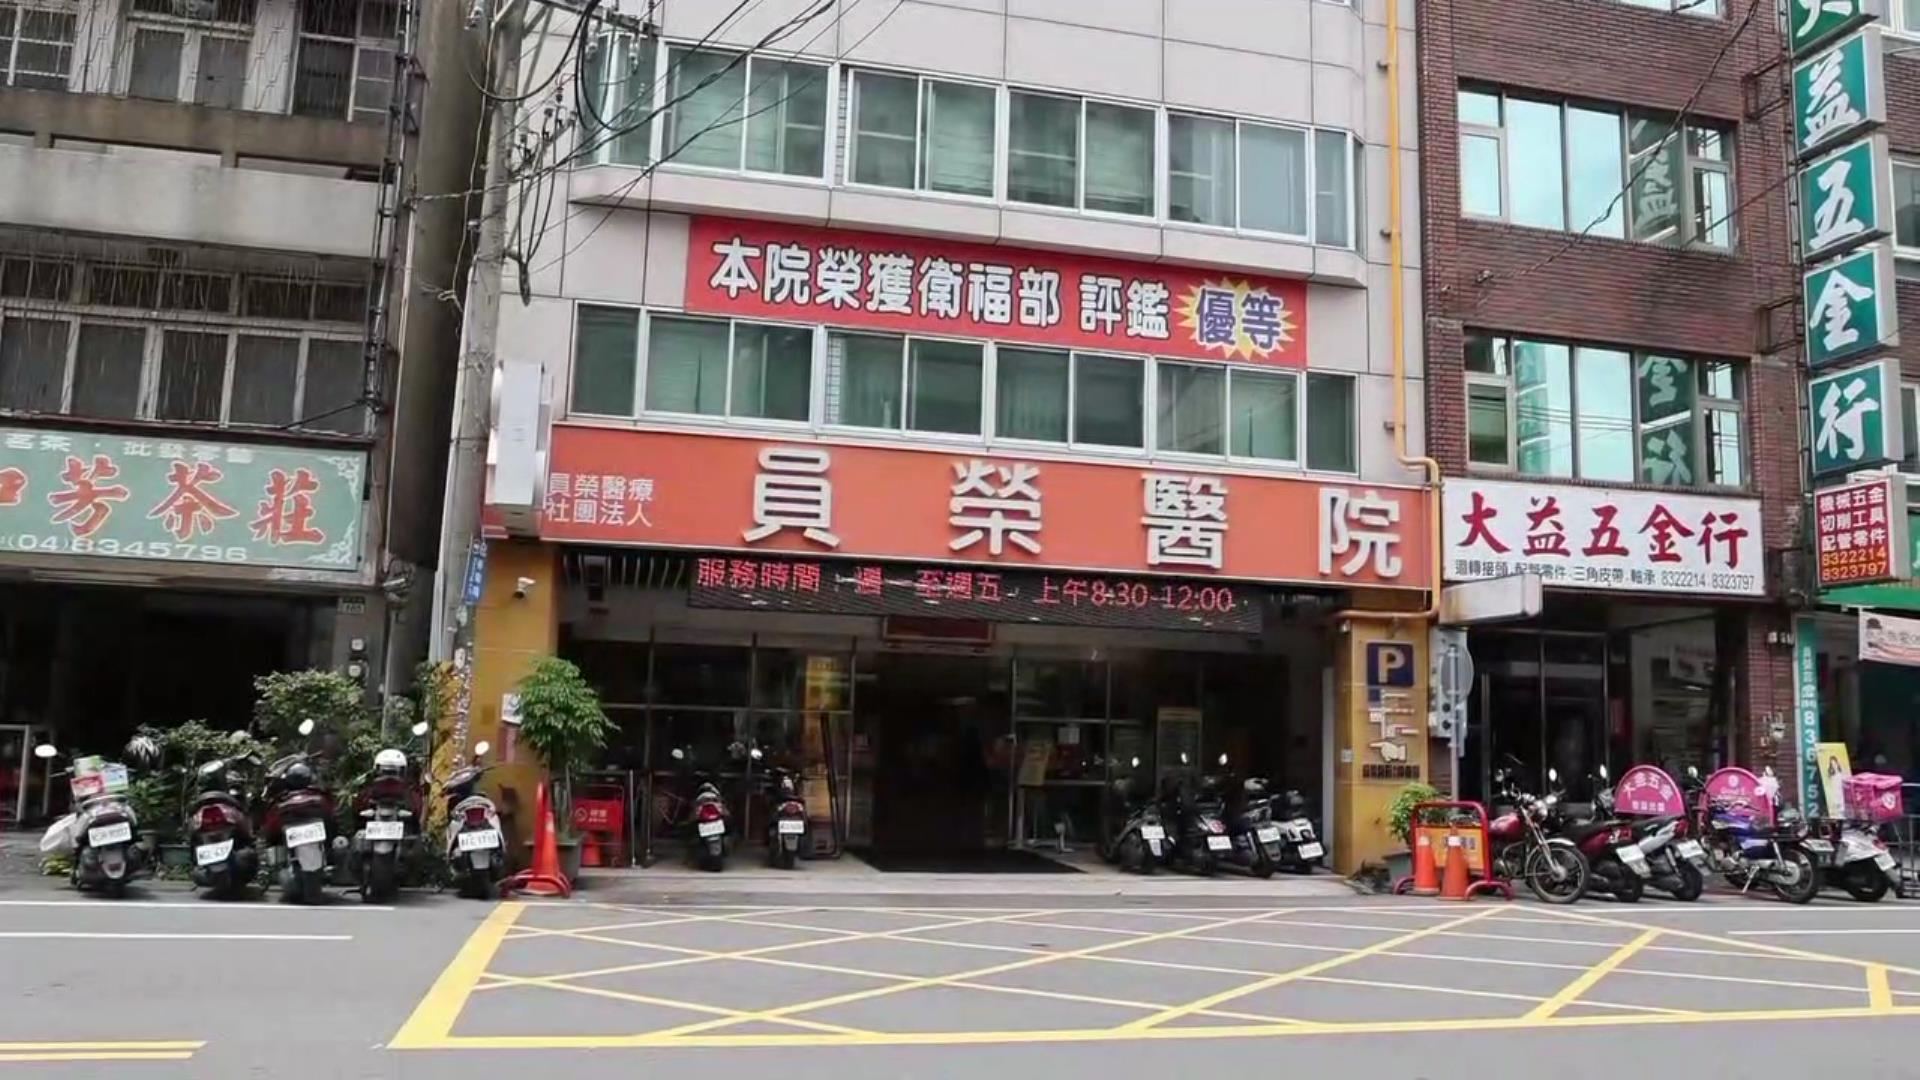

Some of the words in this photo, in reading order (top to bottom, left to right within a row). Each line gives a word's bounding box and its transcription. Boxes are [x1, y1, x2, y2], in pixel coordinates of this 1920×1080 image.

[709, 236, 1062, 327] 本院榮獲衛福部
[1080, 274, 1171, 340] 評鑑
[1196, 286, 1285, 352] 優等
[548, 472, 654, 502] 員榮醫療
[545, 497, 653, 528] 社團法人
[742, 445, 1404, 580] 員榮醫院
[1457, 491, 1749, 569] 大益五金行
[1822, 546, 1886, 567] 8322214
[1822, 562, 1887, 580] 8323797
[1378, 648, 1405, 683] P
